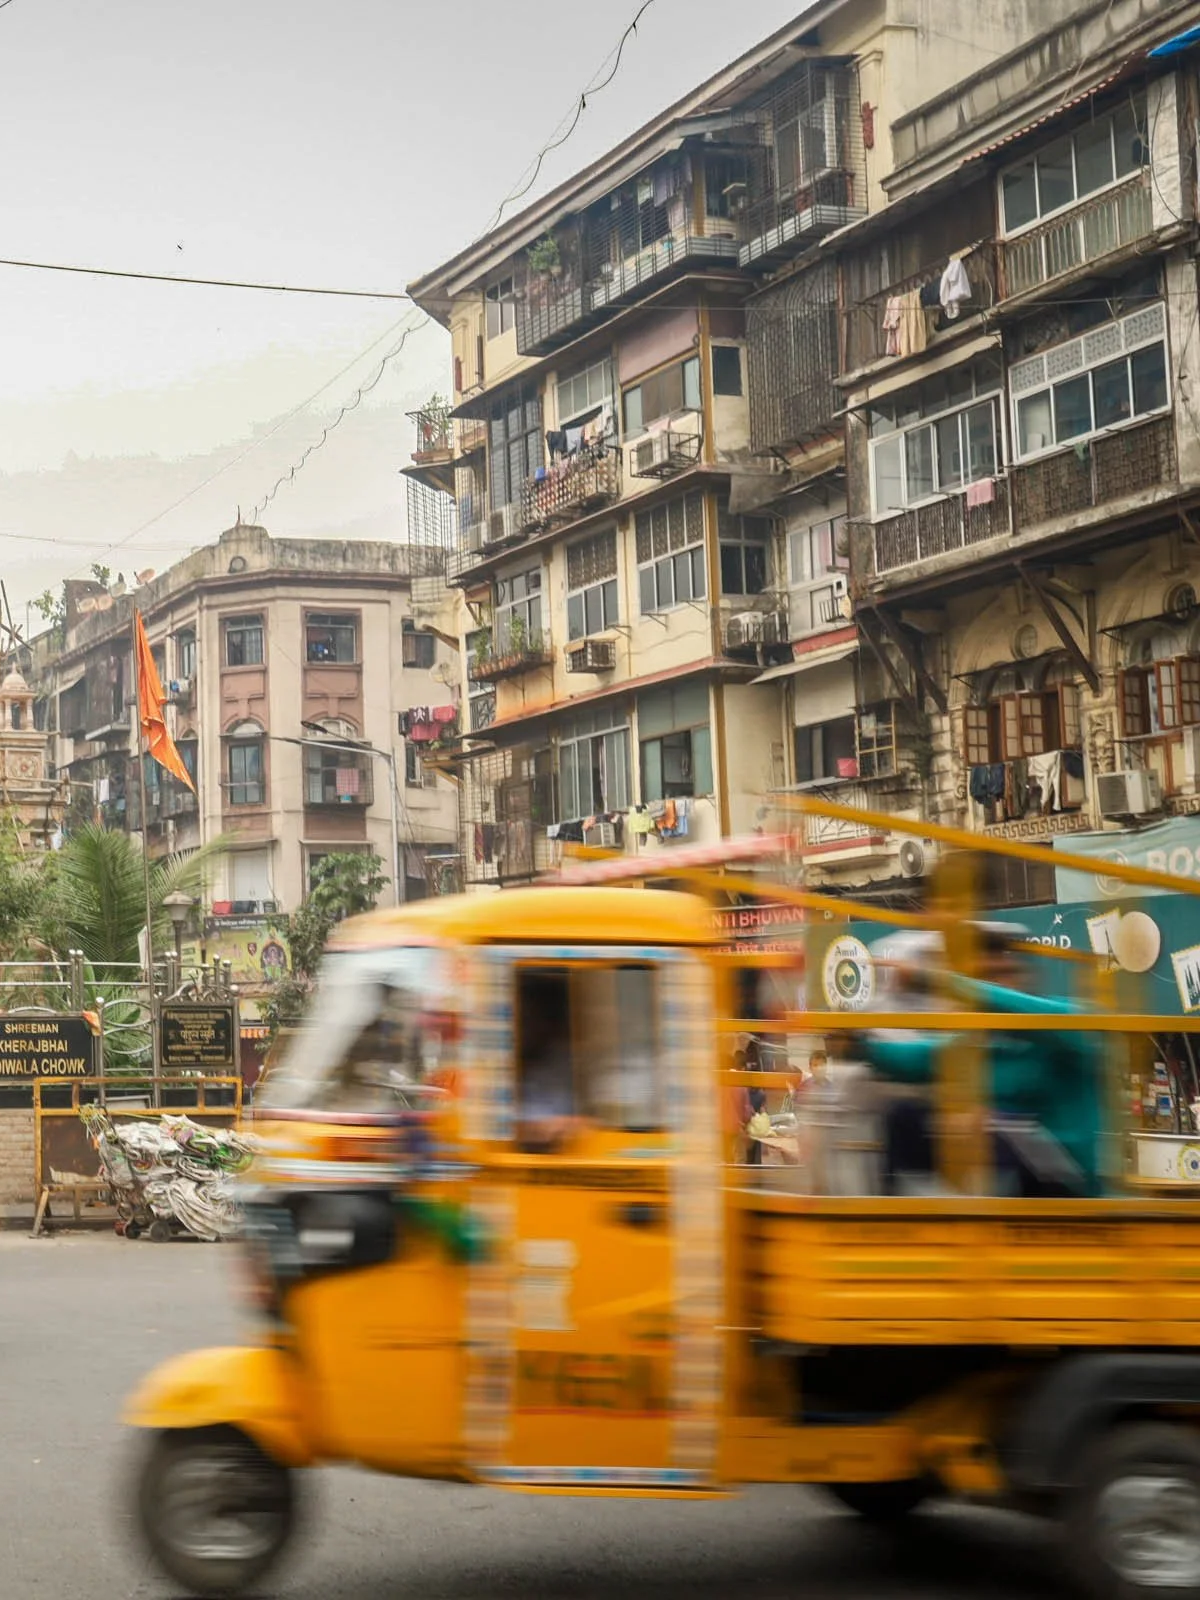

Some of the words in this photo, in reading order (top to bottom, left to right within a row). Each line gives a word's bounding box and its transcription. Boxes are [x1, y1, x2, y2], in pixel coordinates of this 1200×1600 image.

[740, 907, 804, 927] BHUVAN
[1025, 934, 1072, 950] ORLD
[4, 1023, 59, 1034] SHREEMAN
[41, 1058, 85, 1074] CHOWK
